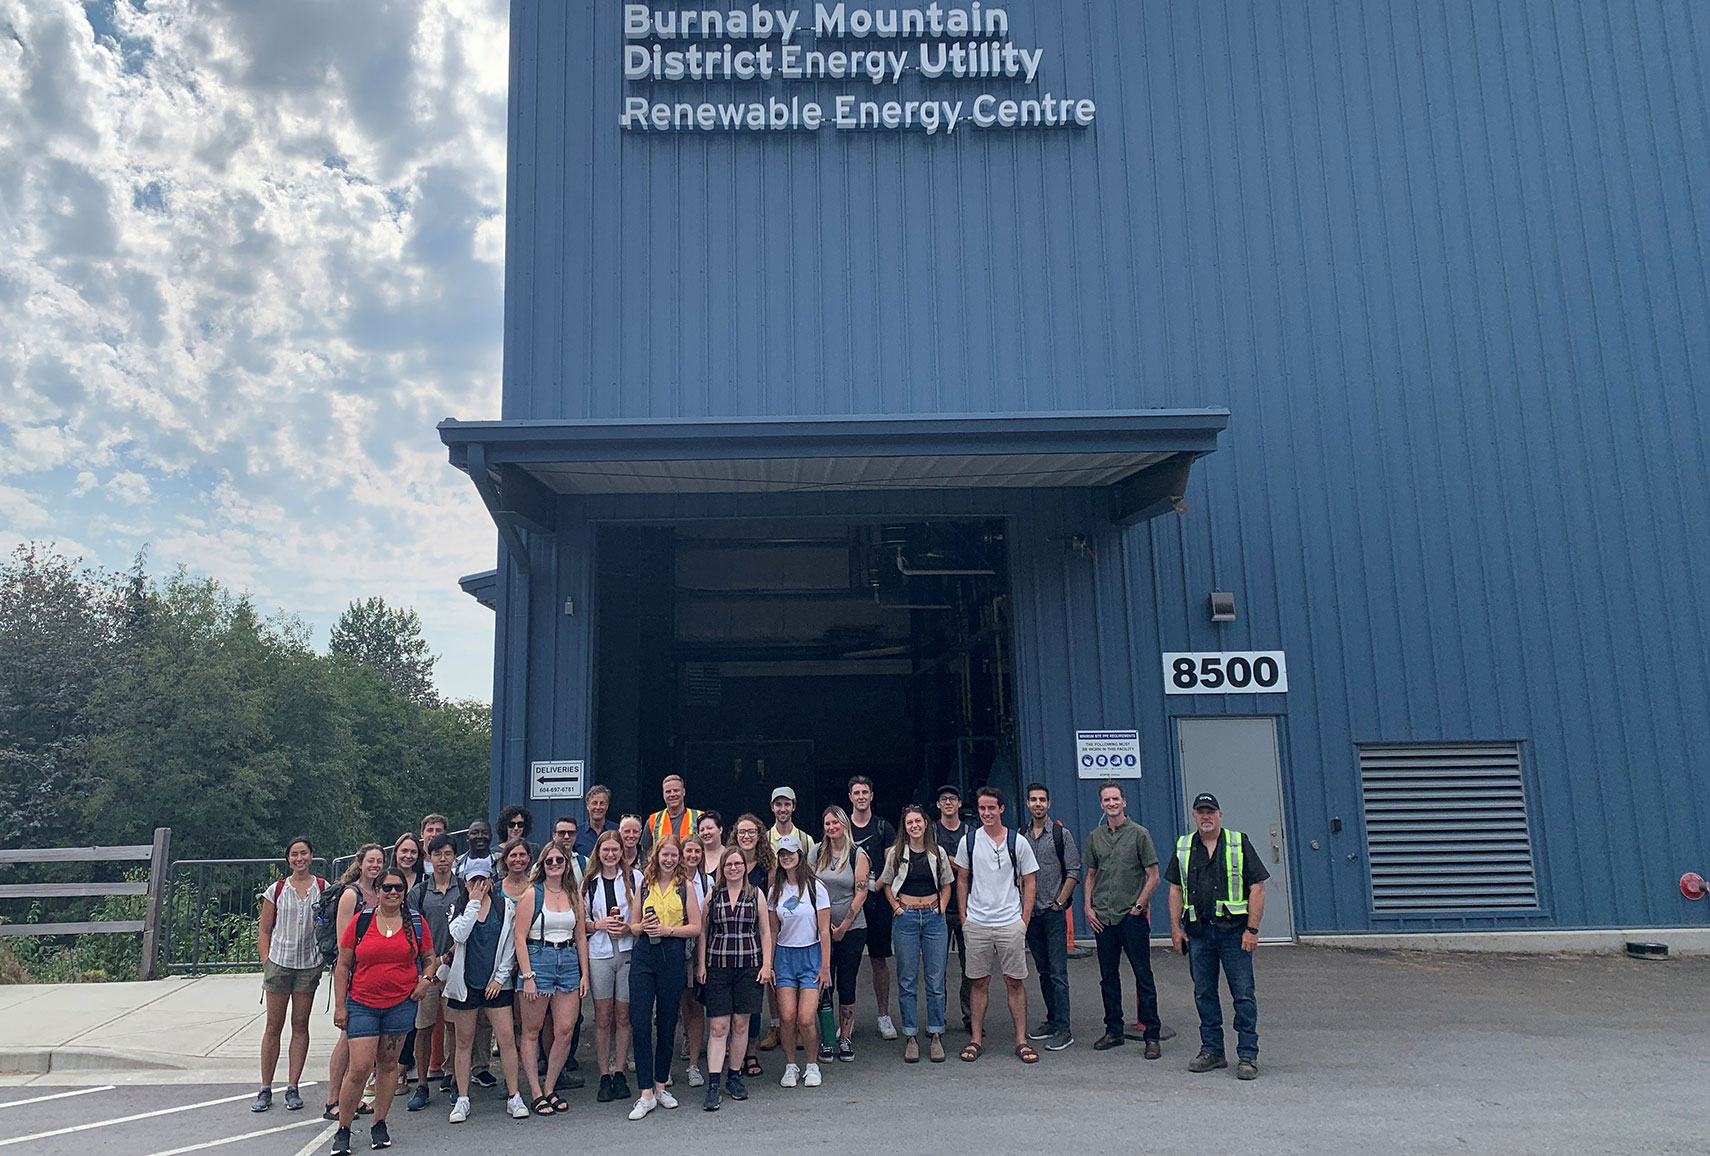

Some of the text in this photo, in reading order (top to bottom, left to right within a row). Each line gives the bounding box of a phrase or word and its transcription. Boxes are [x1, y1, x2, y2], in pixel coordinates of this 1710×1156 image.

[624, 1, 1008, 45] Burnaby Mountain
[624, 41, 1043, 84] District Energy Utility
[625, 92, 1096, 135] Renewable Energy Centre
[1172, 656, 1279, 689] 8500
